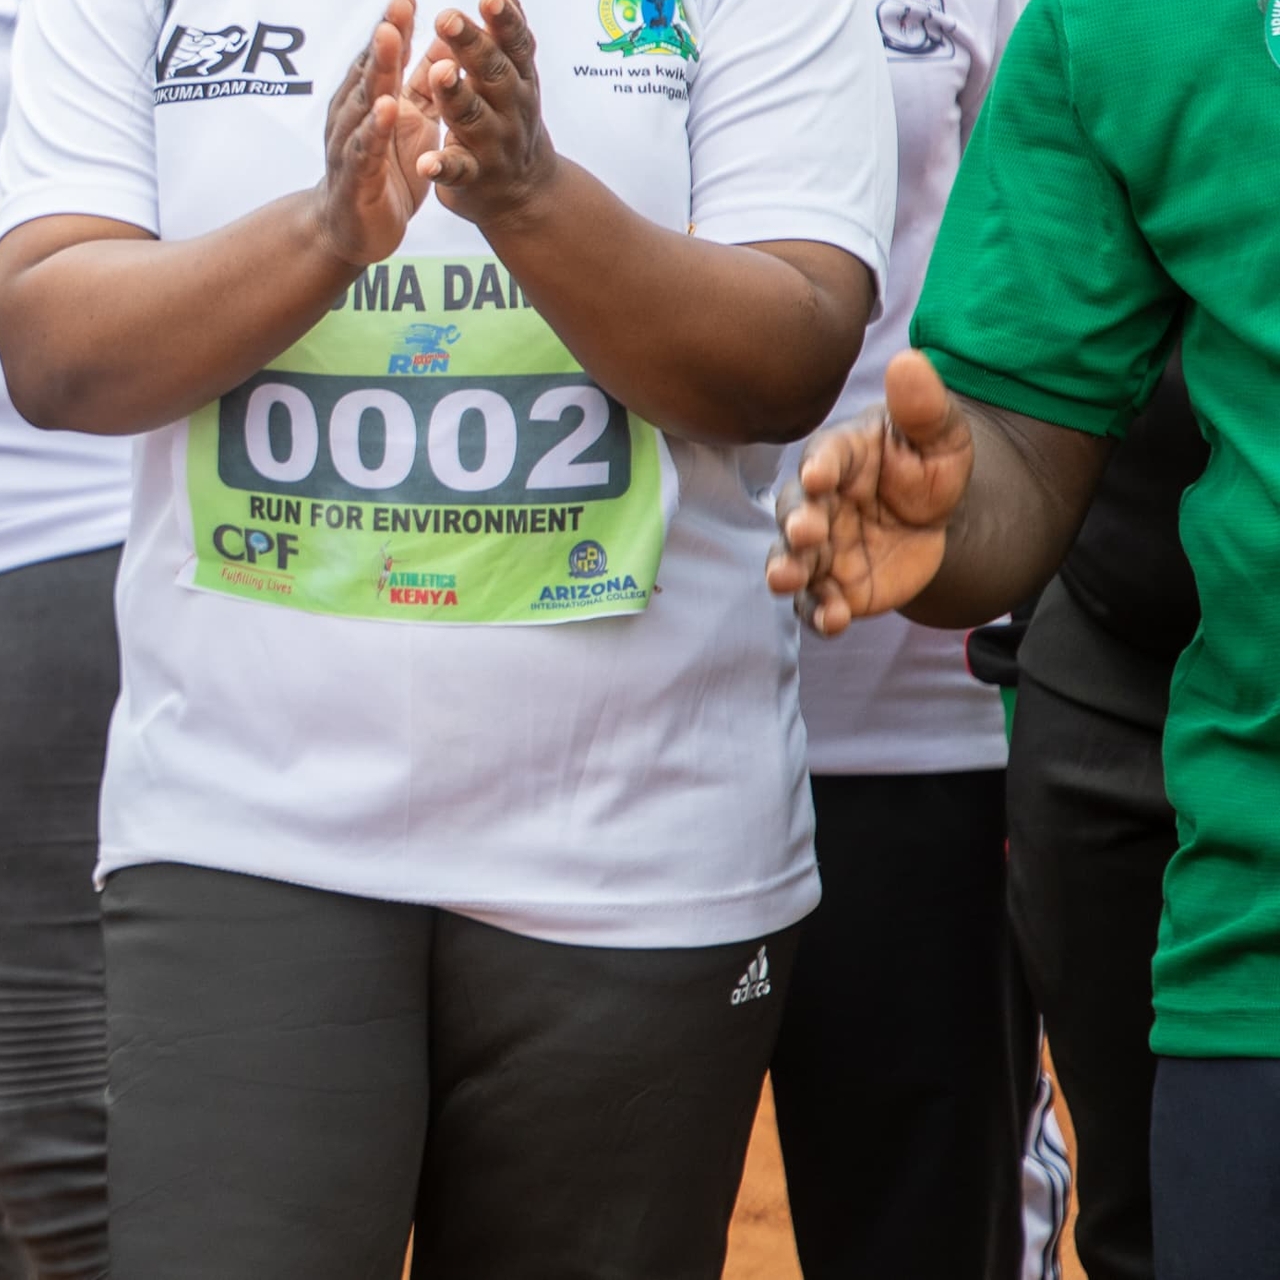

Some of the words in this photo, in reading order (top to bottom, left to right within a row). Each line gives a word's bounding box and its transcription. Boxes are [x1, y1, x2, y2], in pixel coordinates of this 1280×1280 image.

[573, 66, 623, 78] Wauni
[628, 67, 651, 78] wa
[656, 65, 689, 82] kwik
[207, 81, 246, 98] DAM
[249, 80, 288, 95] RUN
[613, 84, 633, 94] na
[245, 382, 610, 492] 0002
[250, 496, 301, 525] RUN
[310, 503, 363, 530] FOR
[372, 505, 584, 534] ENVIRONMENT
[213, 524, 299, 570] CPF
[221, 568, 263, 591] Fulfilling
[266, 579, 293, 595] Lives
[389, 573, 456, 588] ATHLETICS
[540, 575, 637, 601] ARIZONA
[390, 588, 458, 605] KENYA
[530, 597, 603, 610] INTERNATIONAL
[606, 590, 647, 602] COLLEGE
